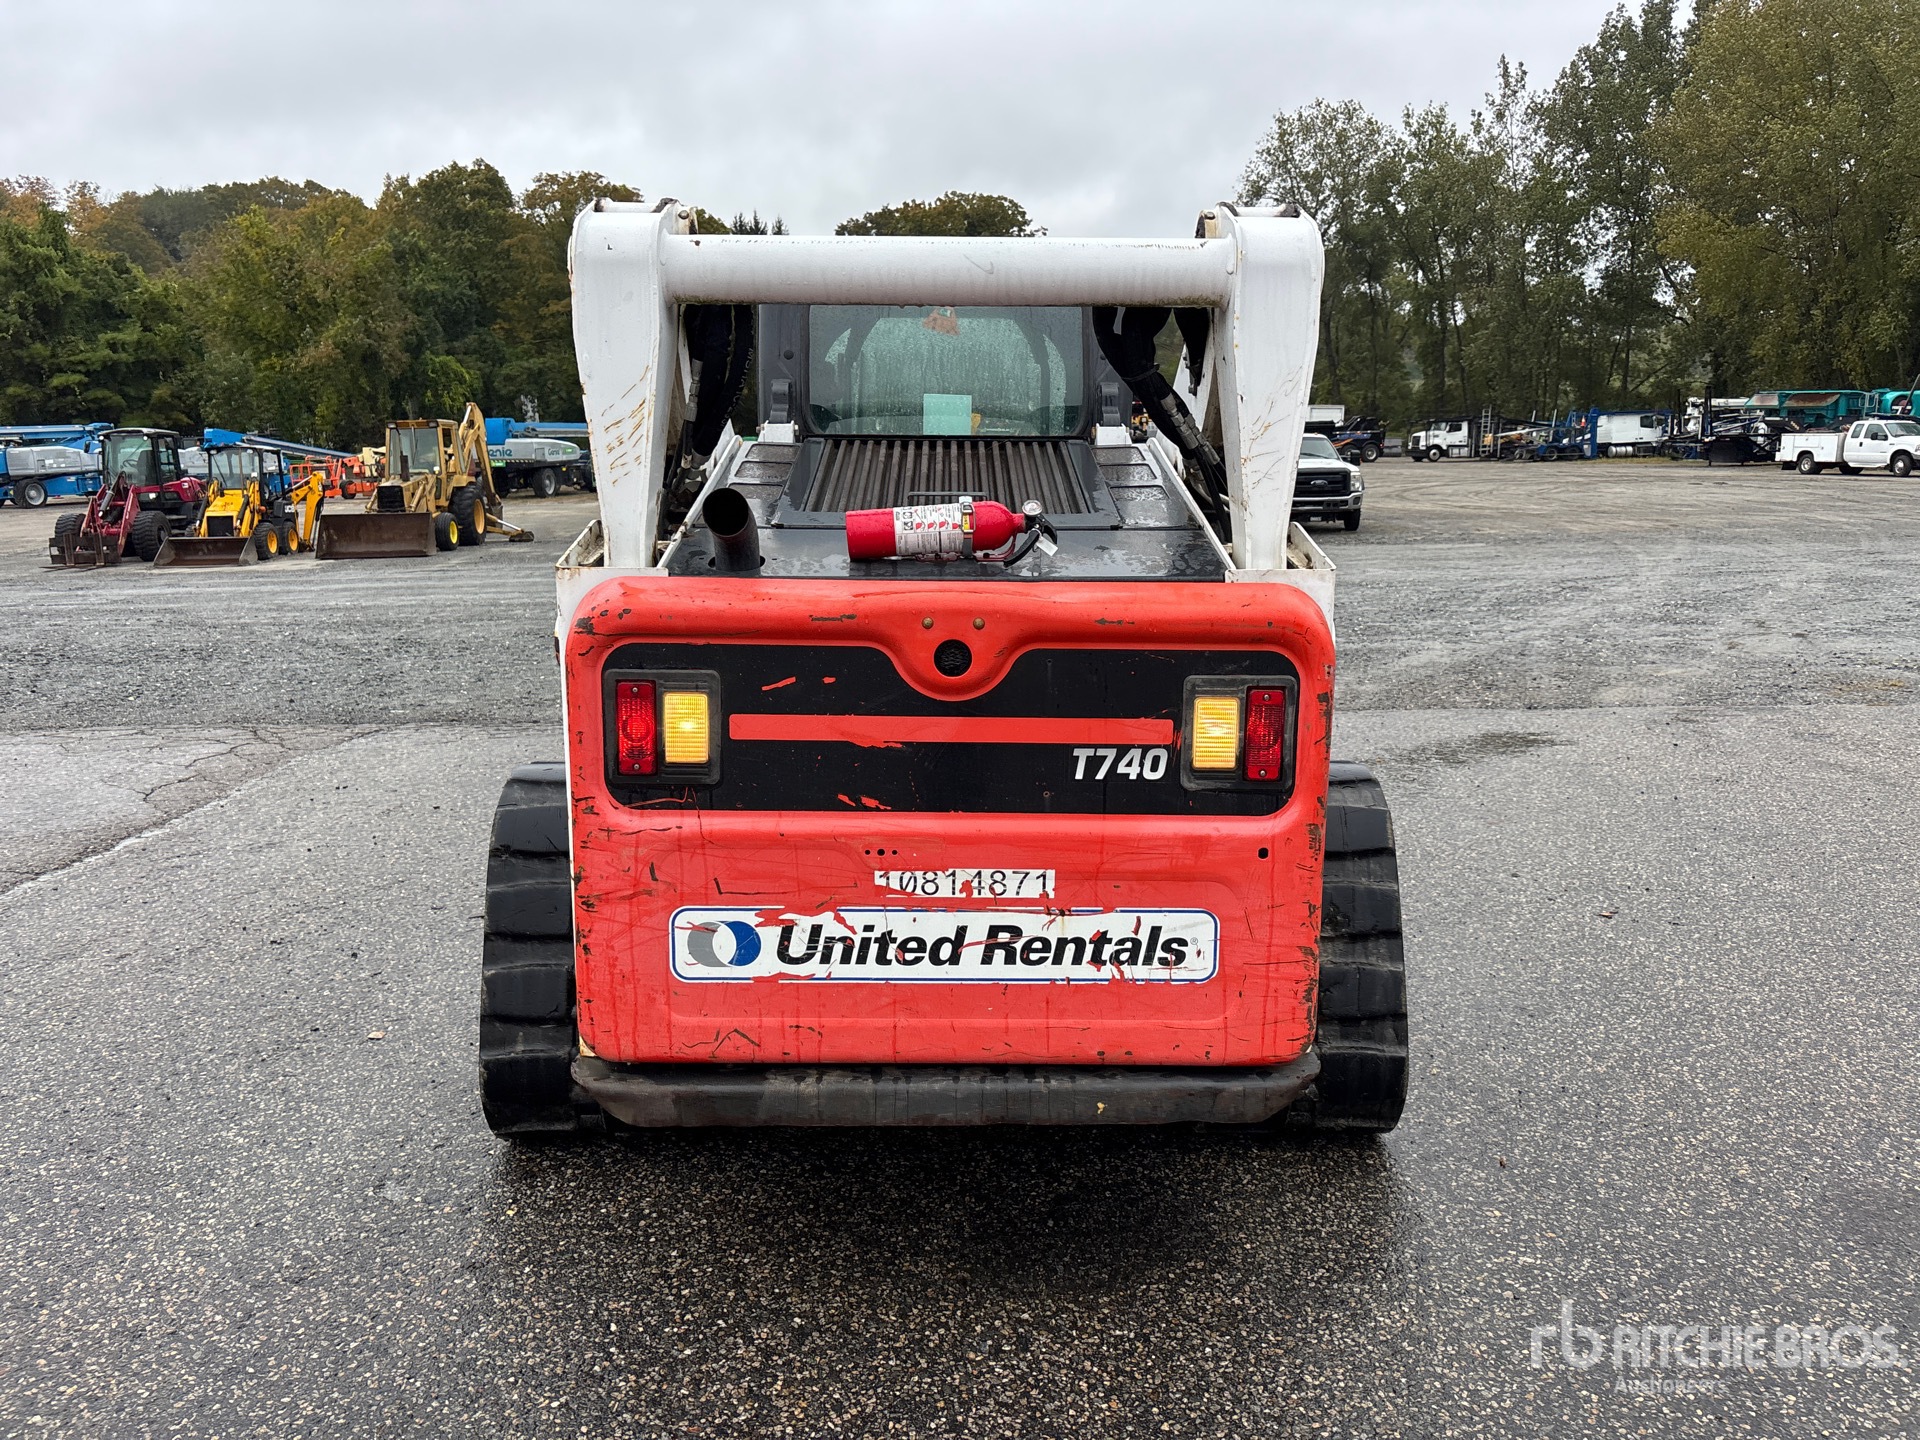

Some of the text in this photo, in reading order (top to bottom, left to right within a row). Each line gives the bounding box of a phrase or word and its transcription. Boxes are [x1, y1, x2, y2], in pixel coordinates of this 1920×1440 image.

[488, 446, 513, 458] enie
[1072, 748, 1168, 780] T740
[879, 869, 1048, 897] 10814871
[776, 923, 1189, 967] United Rentals
